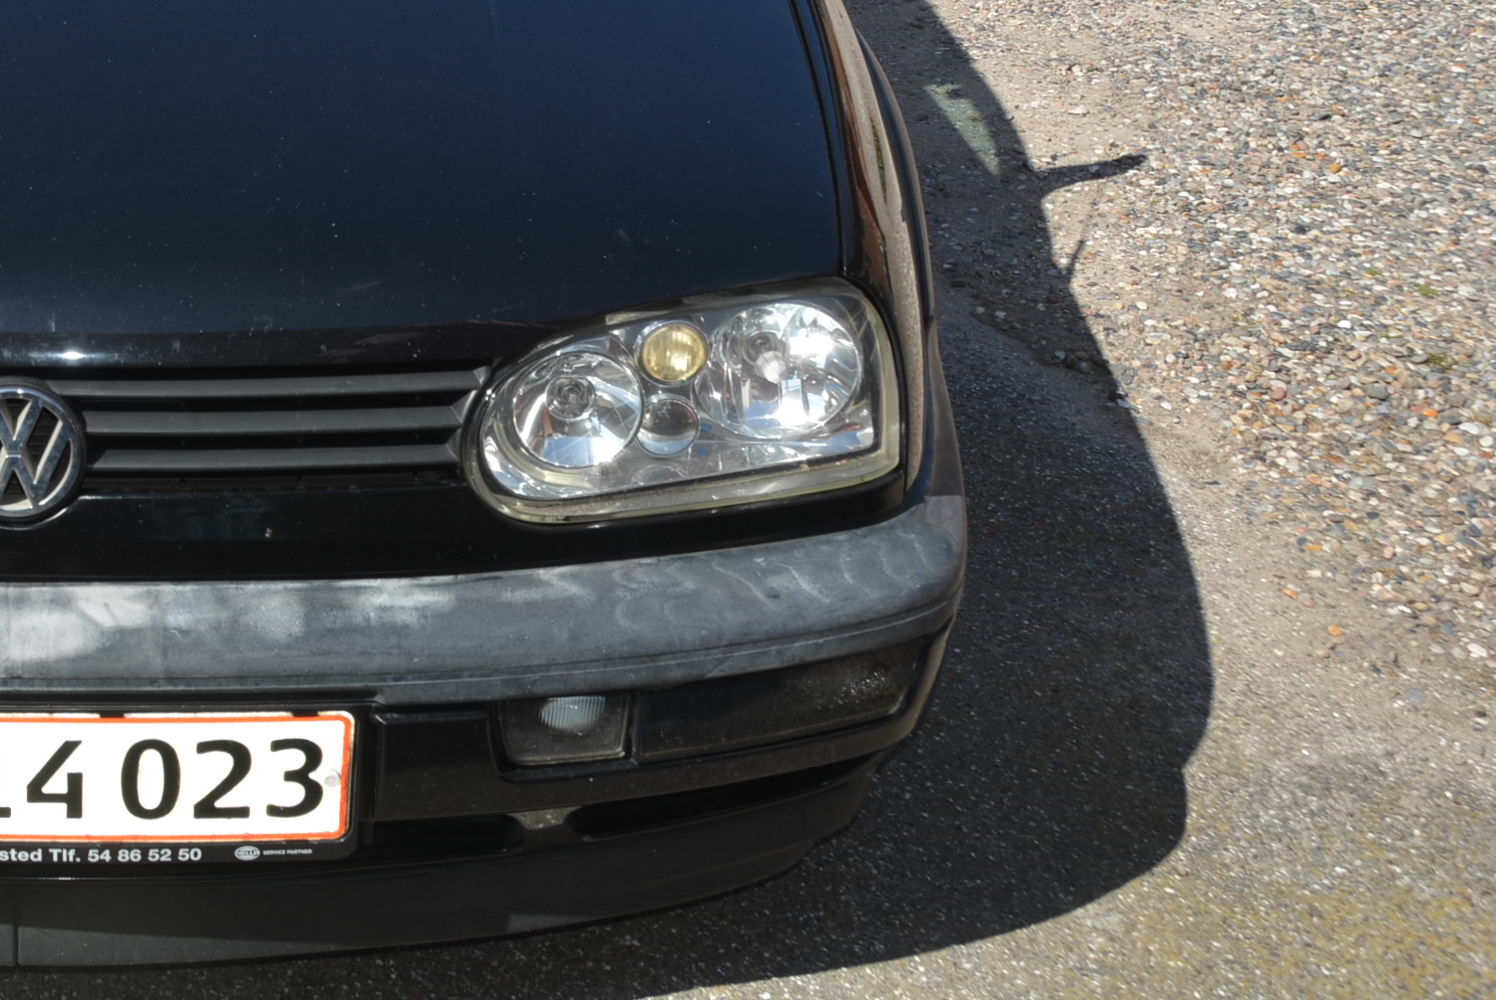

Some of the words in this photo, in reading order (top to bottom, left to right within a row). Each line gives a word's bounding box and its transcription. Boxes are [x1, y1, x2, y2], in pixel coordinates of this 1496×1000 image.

[121, 737, 324, 820] 023
[48, 848, 81, 862] Tlf.
[87, 848, 112, 863] 54
[117, 848, 142, 862] 86
[147, 848, 172, 862] 52
[177, 848, 203, 862] 50
